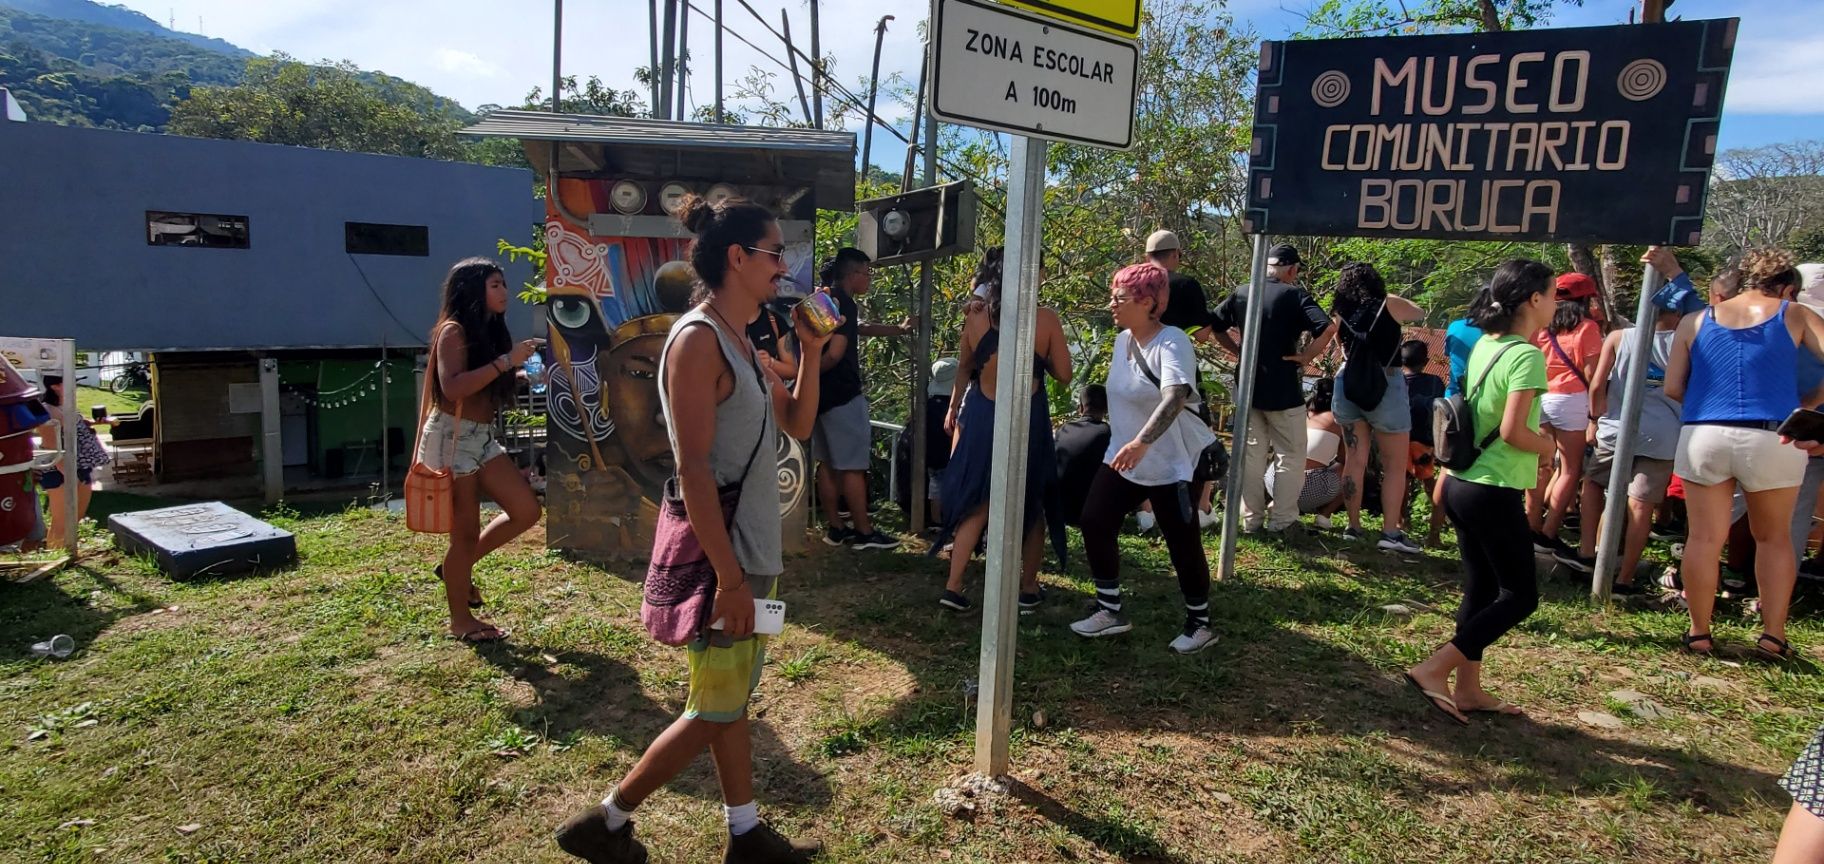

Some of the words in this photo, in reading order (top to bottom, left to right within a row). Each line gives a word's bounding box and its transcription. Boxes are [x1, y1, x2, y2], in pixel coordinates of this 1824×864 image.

[965, 28, 1023, 64] ZONA
[1033, 46, 1114, 84] ESCOLAR
[1370, 50, 1591, 116] MUSEO
[1005, 80, 1018, 102] A
[1033, 86, 1076, 114] 100m
[1321, 120, 1631, 171] COMUNITARIO
[1357, 178, 1562, 233] BORUCA
